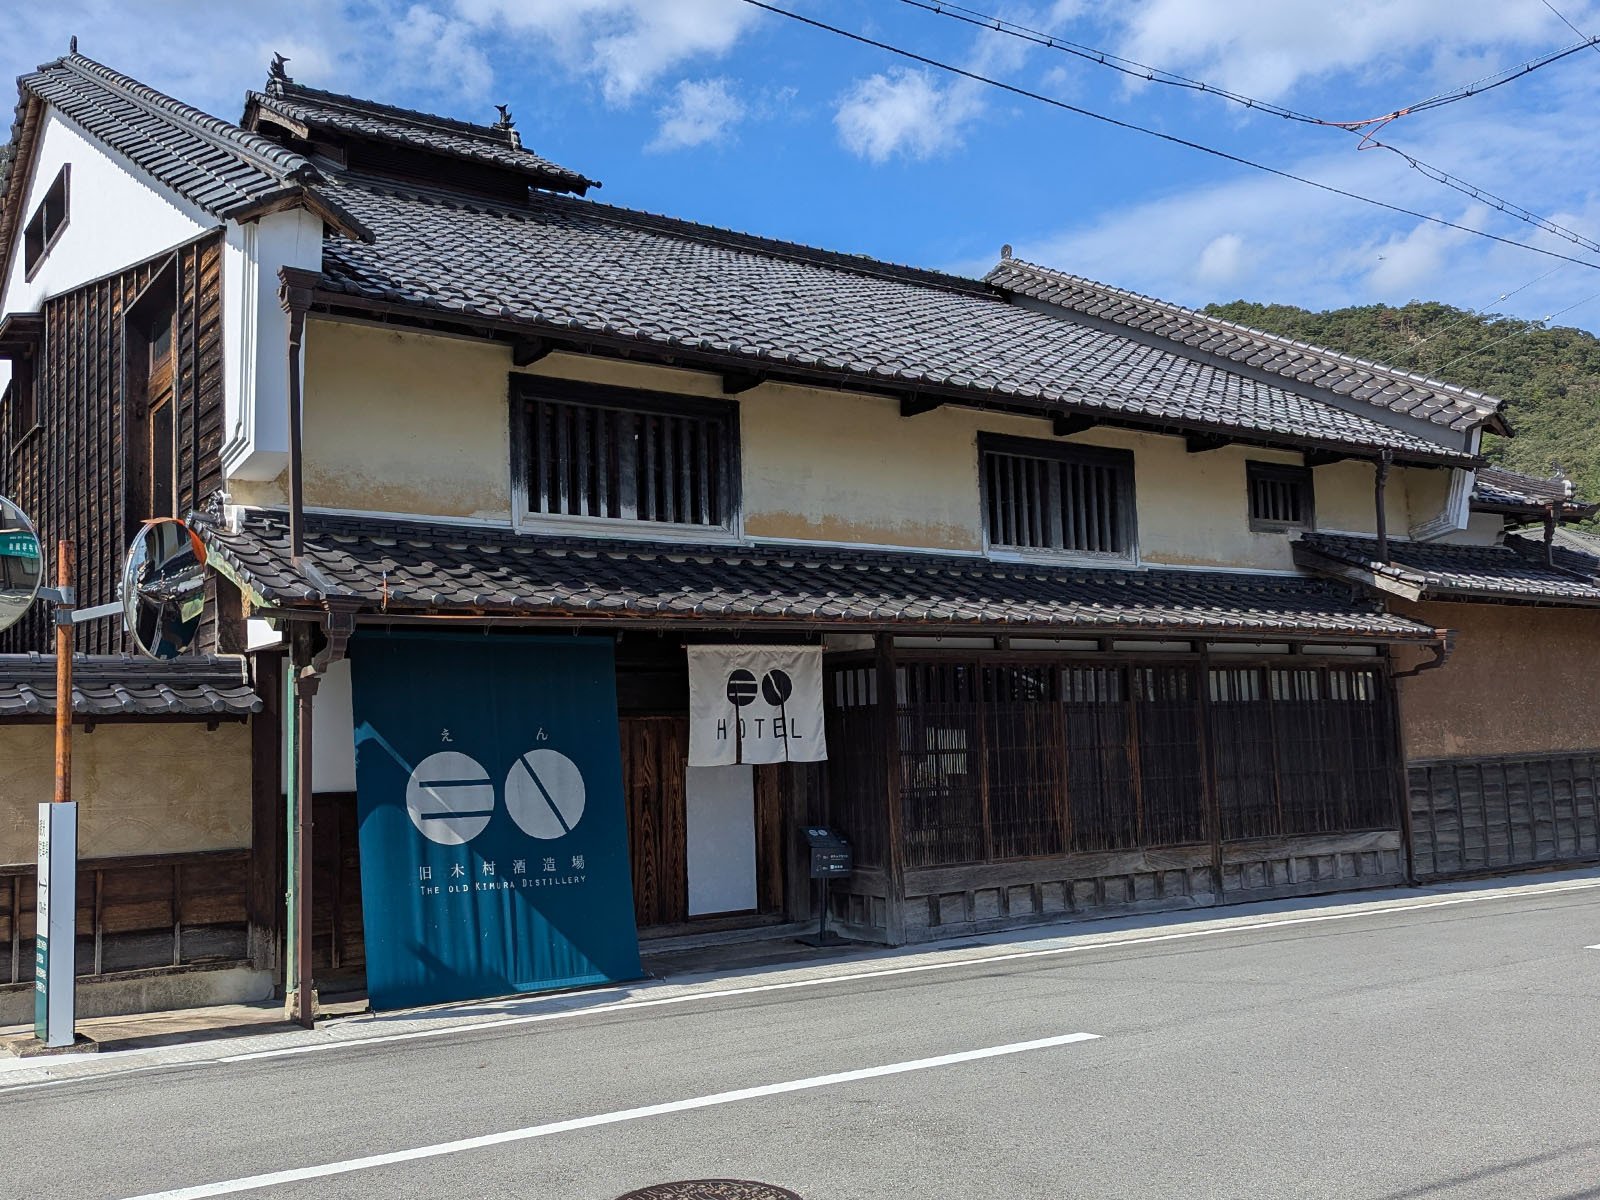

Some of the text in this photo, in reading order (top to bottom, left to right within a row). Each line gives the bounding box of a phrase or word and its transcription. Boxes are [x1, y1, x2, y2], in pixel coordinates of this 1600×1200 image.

[441, 727, 548, 742] え ん
[717, 718, 802, 740] HOTEL
[419, 855, 585, 881] 旧木村酒造場
[475, 881, 515, 891] KIMURA
[522, 875, 586, 888] DISTILLERY
